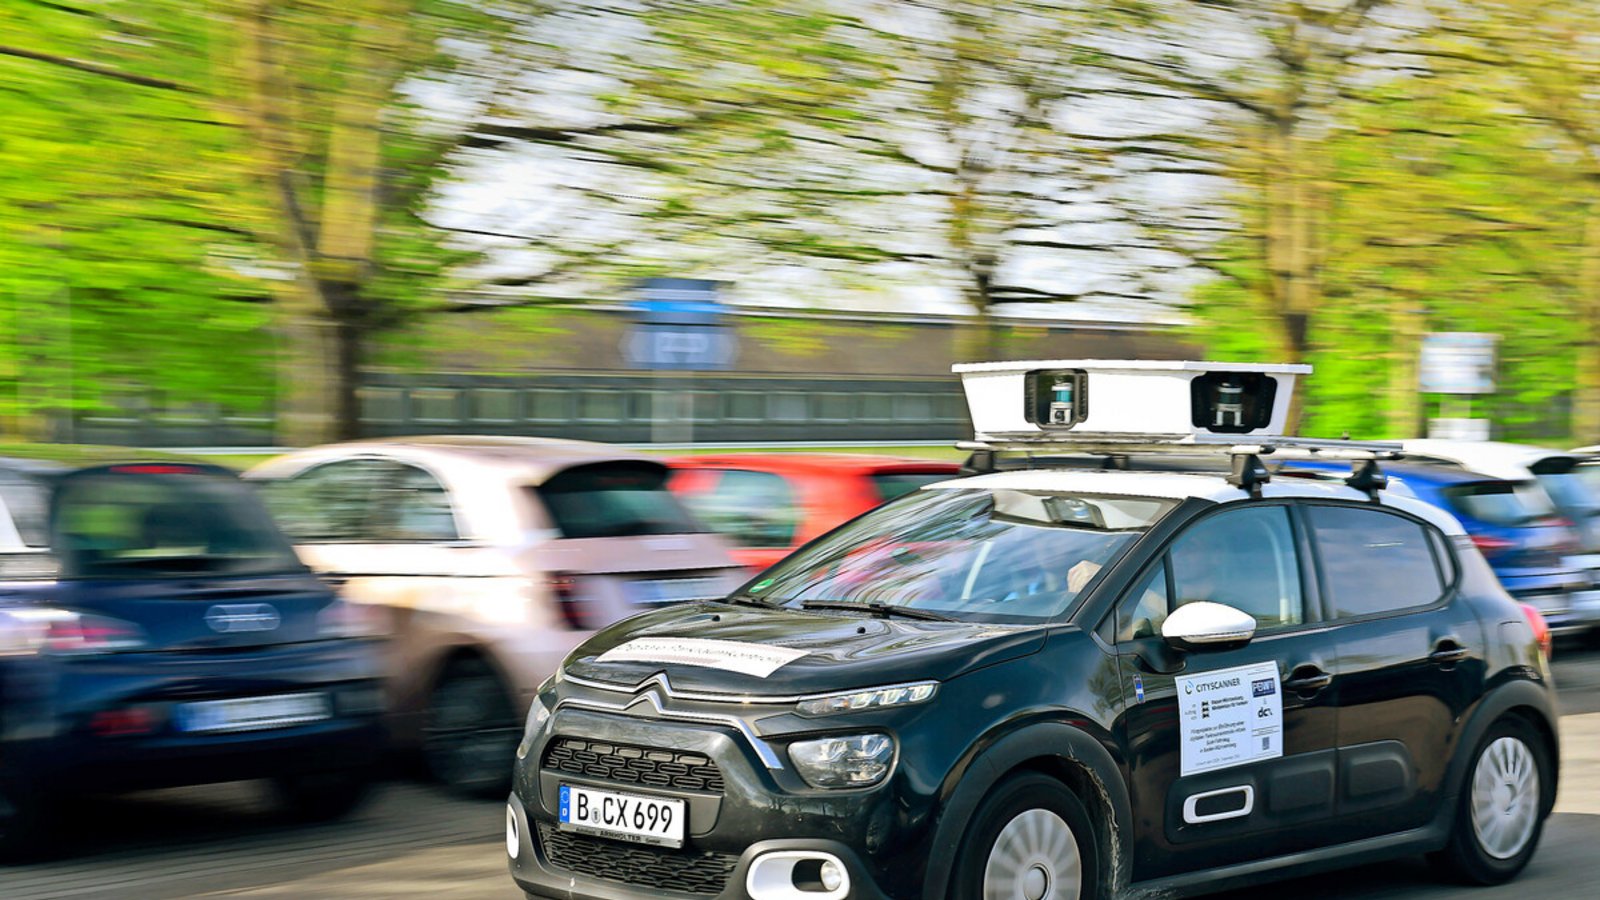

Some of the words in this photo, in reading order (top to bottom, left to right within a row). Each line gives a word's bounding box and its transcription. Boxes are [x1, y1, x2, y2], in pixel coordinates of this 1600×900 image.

[1196, 678, 1241, 693] CITYSCANNER
[577, 793, 589, 821] B
[603, 797, 628, 828] CX
[633, 801, 673, 833] 699
